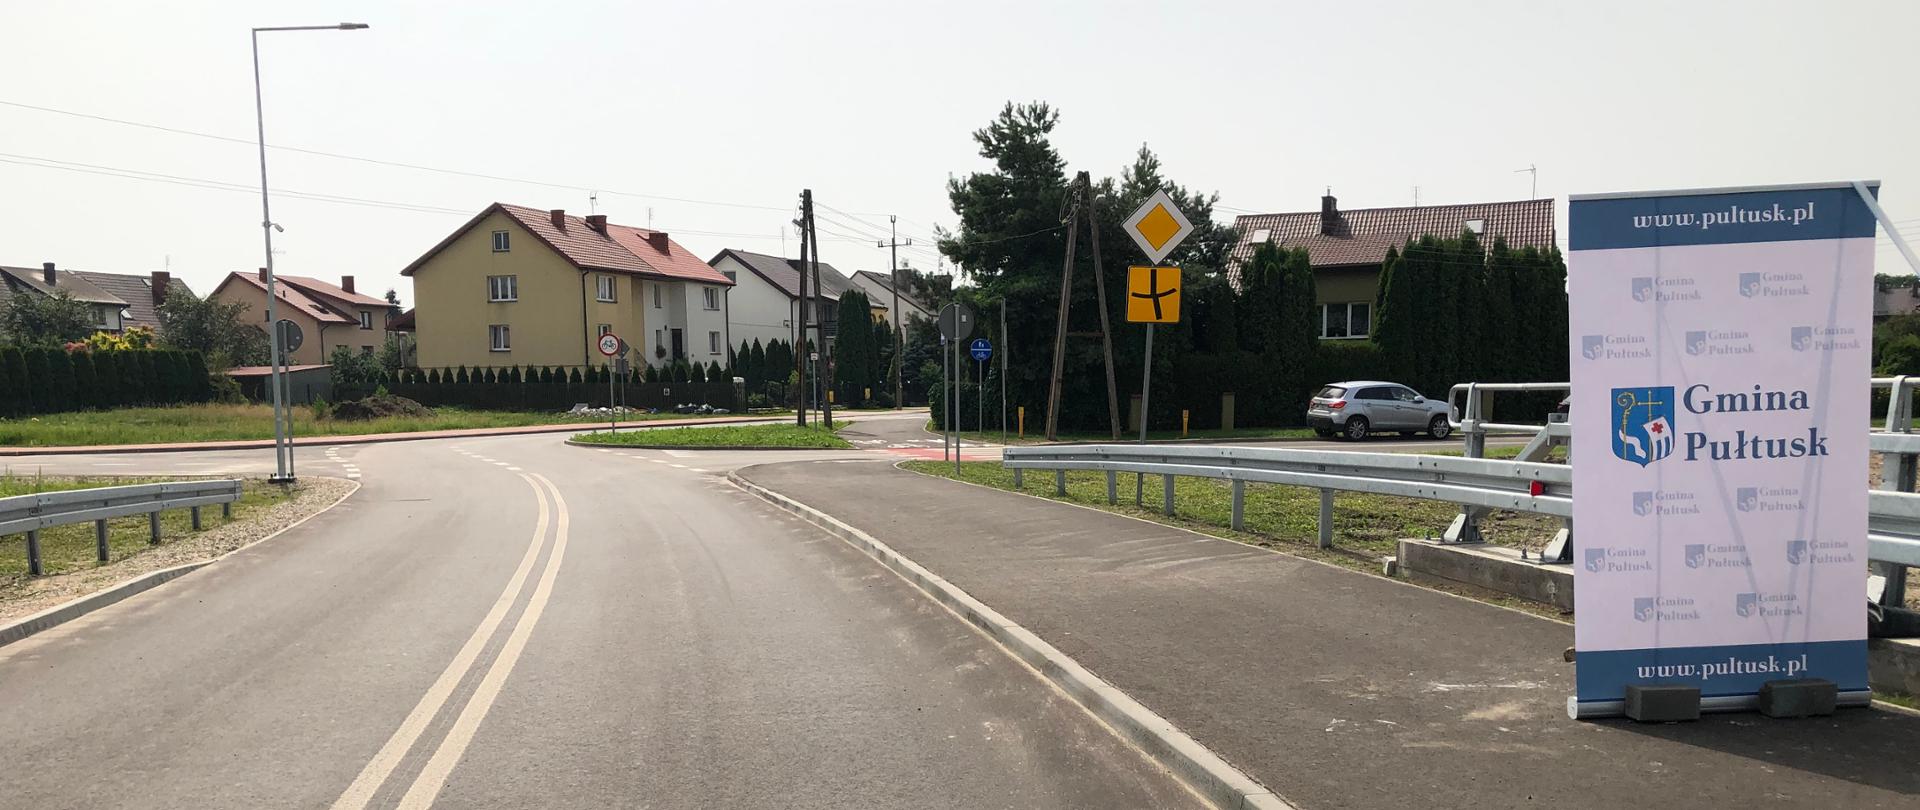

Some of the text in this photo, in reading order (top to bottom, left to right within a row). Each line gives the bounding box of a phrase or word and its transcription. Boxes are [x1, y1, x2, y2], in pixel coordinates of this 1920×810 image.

[1633, 203, 1814, 229] www.pultusk.pl
[1762, 272, 1803, 281] Gmina
[1655, 277, 1695, 286] Gmina
[1708, 330, 1749, 339] Gmina
[1814, 326, 1855, 335] Gmina
[1605, 334, 1645, 343] Gmina
[1683, 383, 1809, 414] Gmina
[1684, 428, 1829, 461] Pułtusk
[1655, 491, 1694, 500] Gmina
[1759, 487, 1798, 496] Gmina
[1707, 544, 1746, 553] Gmina
[1809, 540, 1848, 549] Gmina
[1607, 548, 1646, 557] Gmina
[1656, 597, 1694, 606] Gmina
[1759, 592, 1797, 602] Gmina
[1637, 655, 1807, 679] www.pultusk.pl
